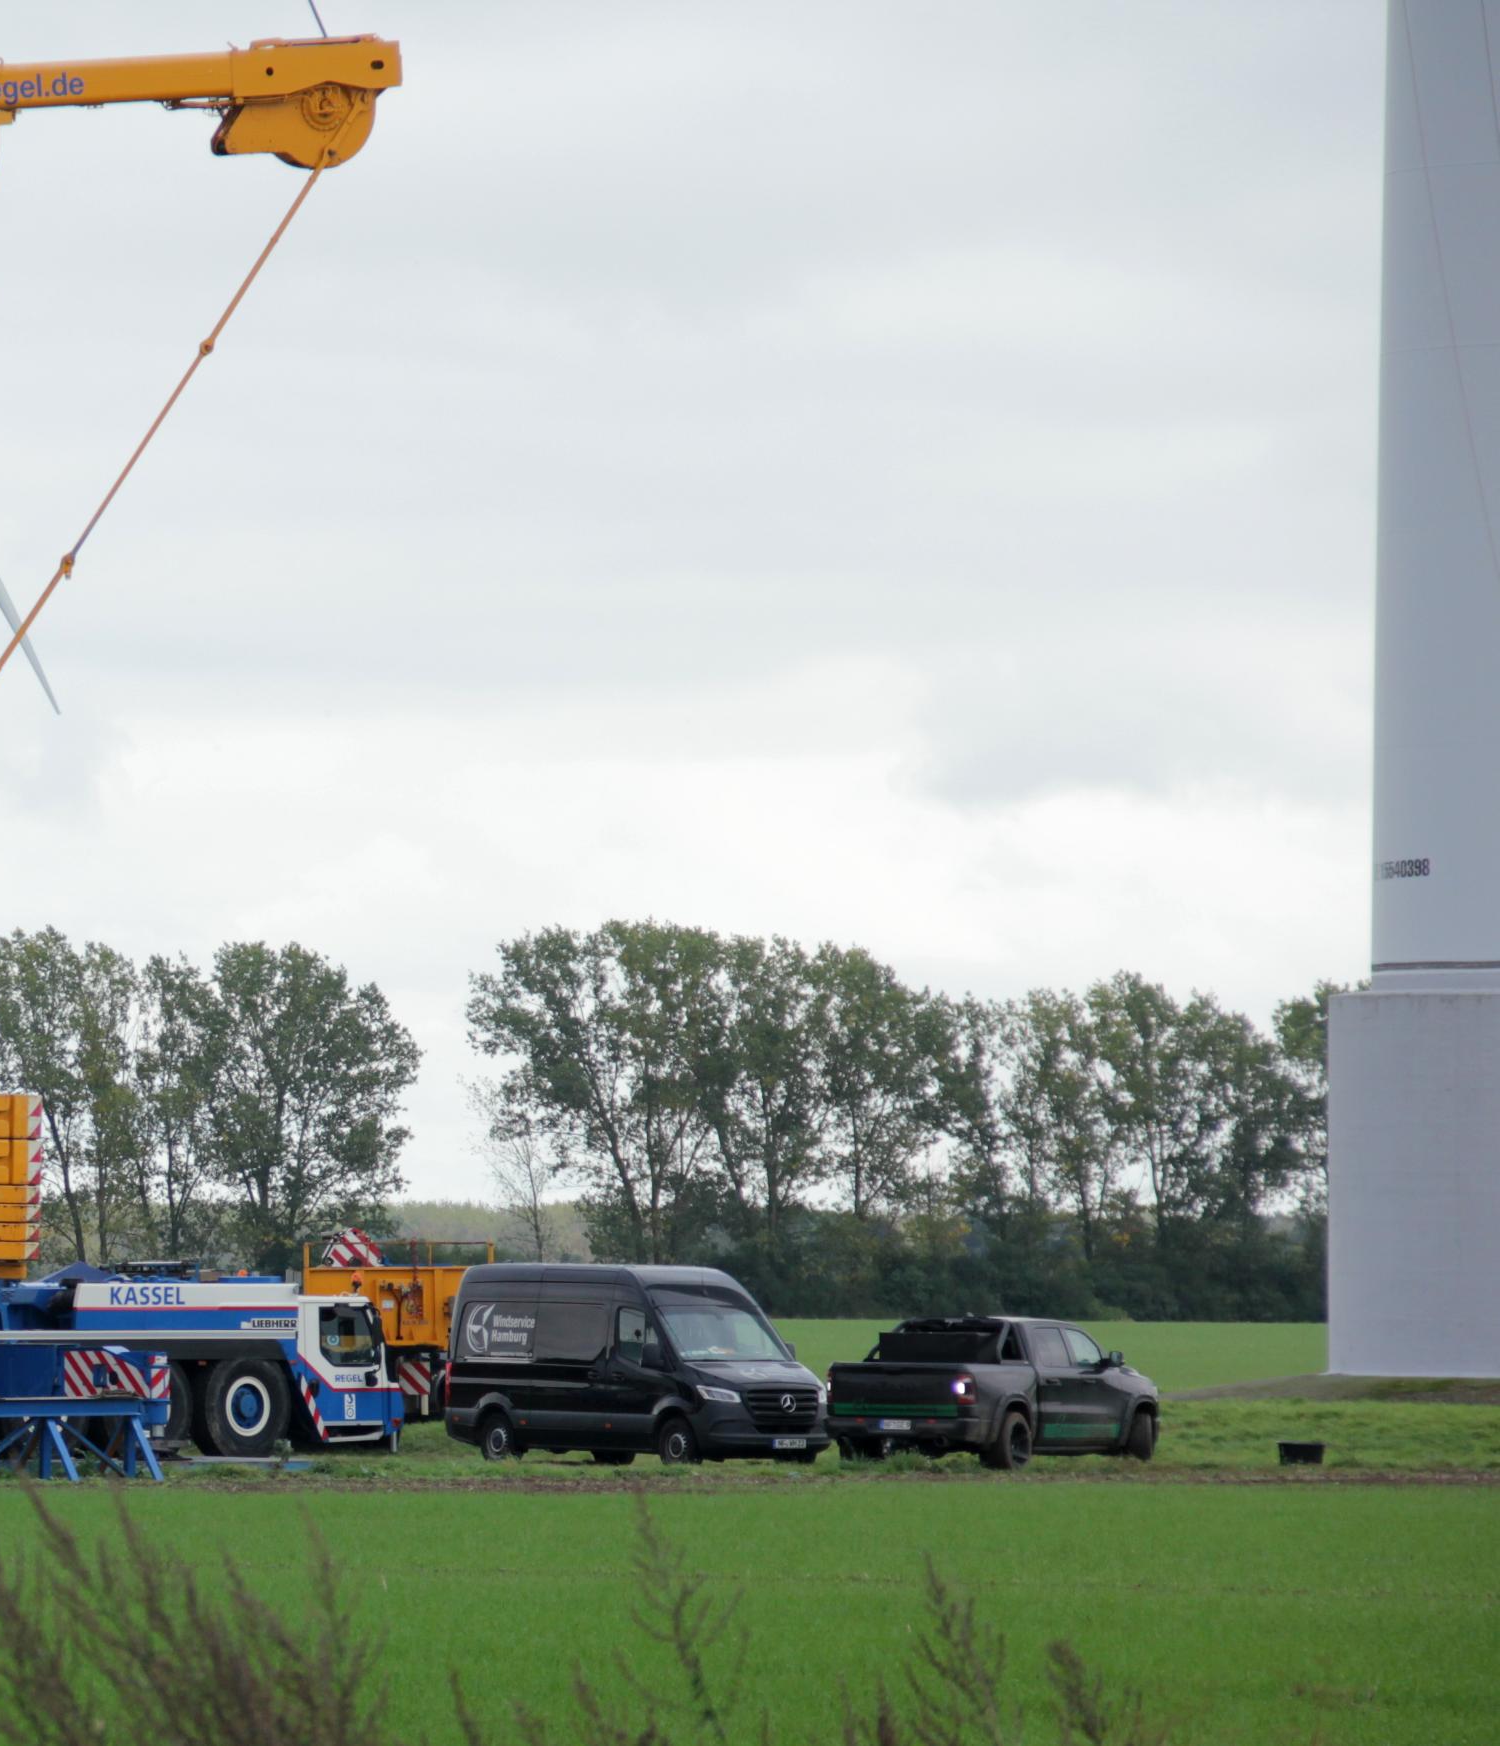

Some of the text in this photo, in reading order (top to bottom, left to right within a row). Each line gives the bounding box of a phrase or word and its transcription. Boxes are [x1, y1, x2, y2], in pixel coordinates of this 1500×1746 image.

[110, 1286, 185, 1305] KASSEL
[252, 1319, 297, 1328] LIEBHERR
[493, 1314, 536, 1329] Windservice
[491, 1329, 528, 1346] Hamburg
[334, 1374, 364, 1383] REGEL
